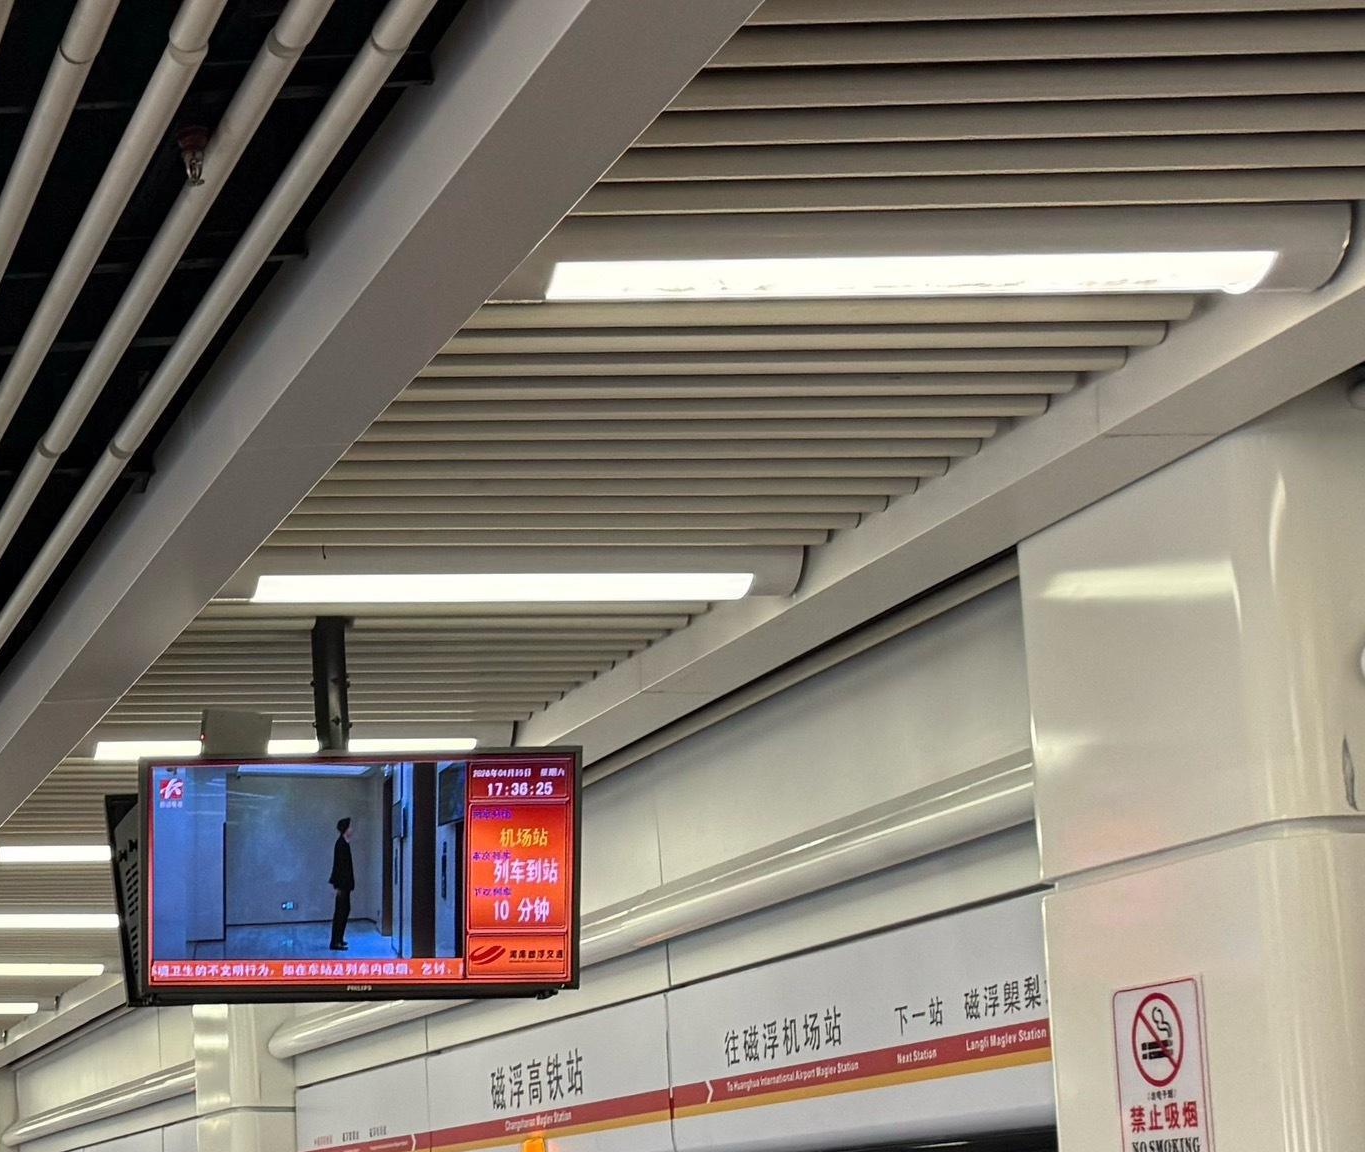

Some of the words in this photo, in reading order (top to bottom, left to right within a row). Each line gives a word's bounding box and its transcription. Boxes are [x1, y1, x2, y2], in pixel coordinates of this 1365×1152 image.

[488, 782, 553, 796] 17:36:25
[500, 828, 548, 847] 机场站
[494, 858, 559, 884] 列车到站
[494, 900, 509, 920] 10
[517, 897, 550, 922] 分钟
[725, 1005, 841, 1067] 往磁浮机场站
[895, 996, 943, 1036] 下一站
[734, 1078, 760, 1092] Huanghua
[760, 1073, 795, 1089] International
[795, 1069, 815, 1083] Airport
[837, 1061, 859, 1073] Station
[897, 1053, 913, 1064] Next
[913, 1048, 937, 1062] Station
[966, 1038, 989, 1052] Langli
[990, 1033, 1017, 1048] Maglev
[1018, 1027, 1047, 1042] Station
[491, 1048, 583, 1110] 磁浮高铁站
[1130, 1101, 1198, 1133] 禁止吸烟
